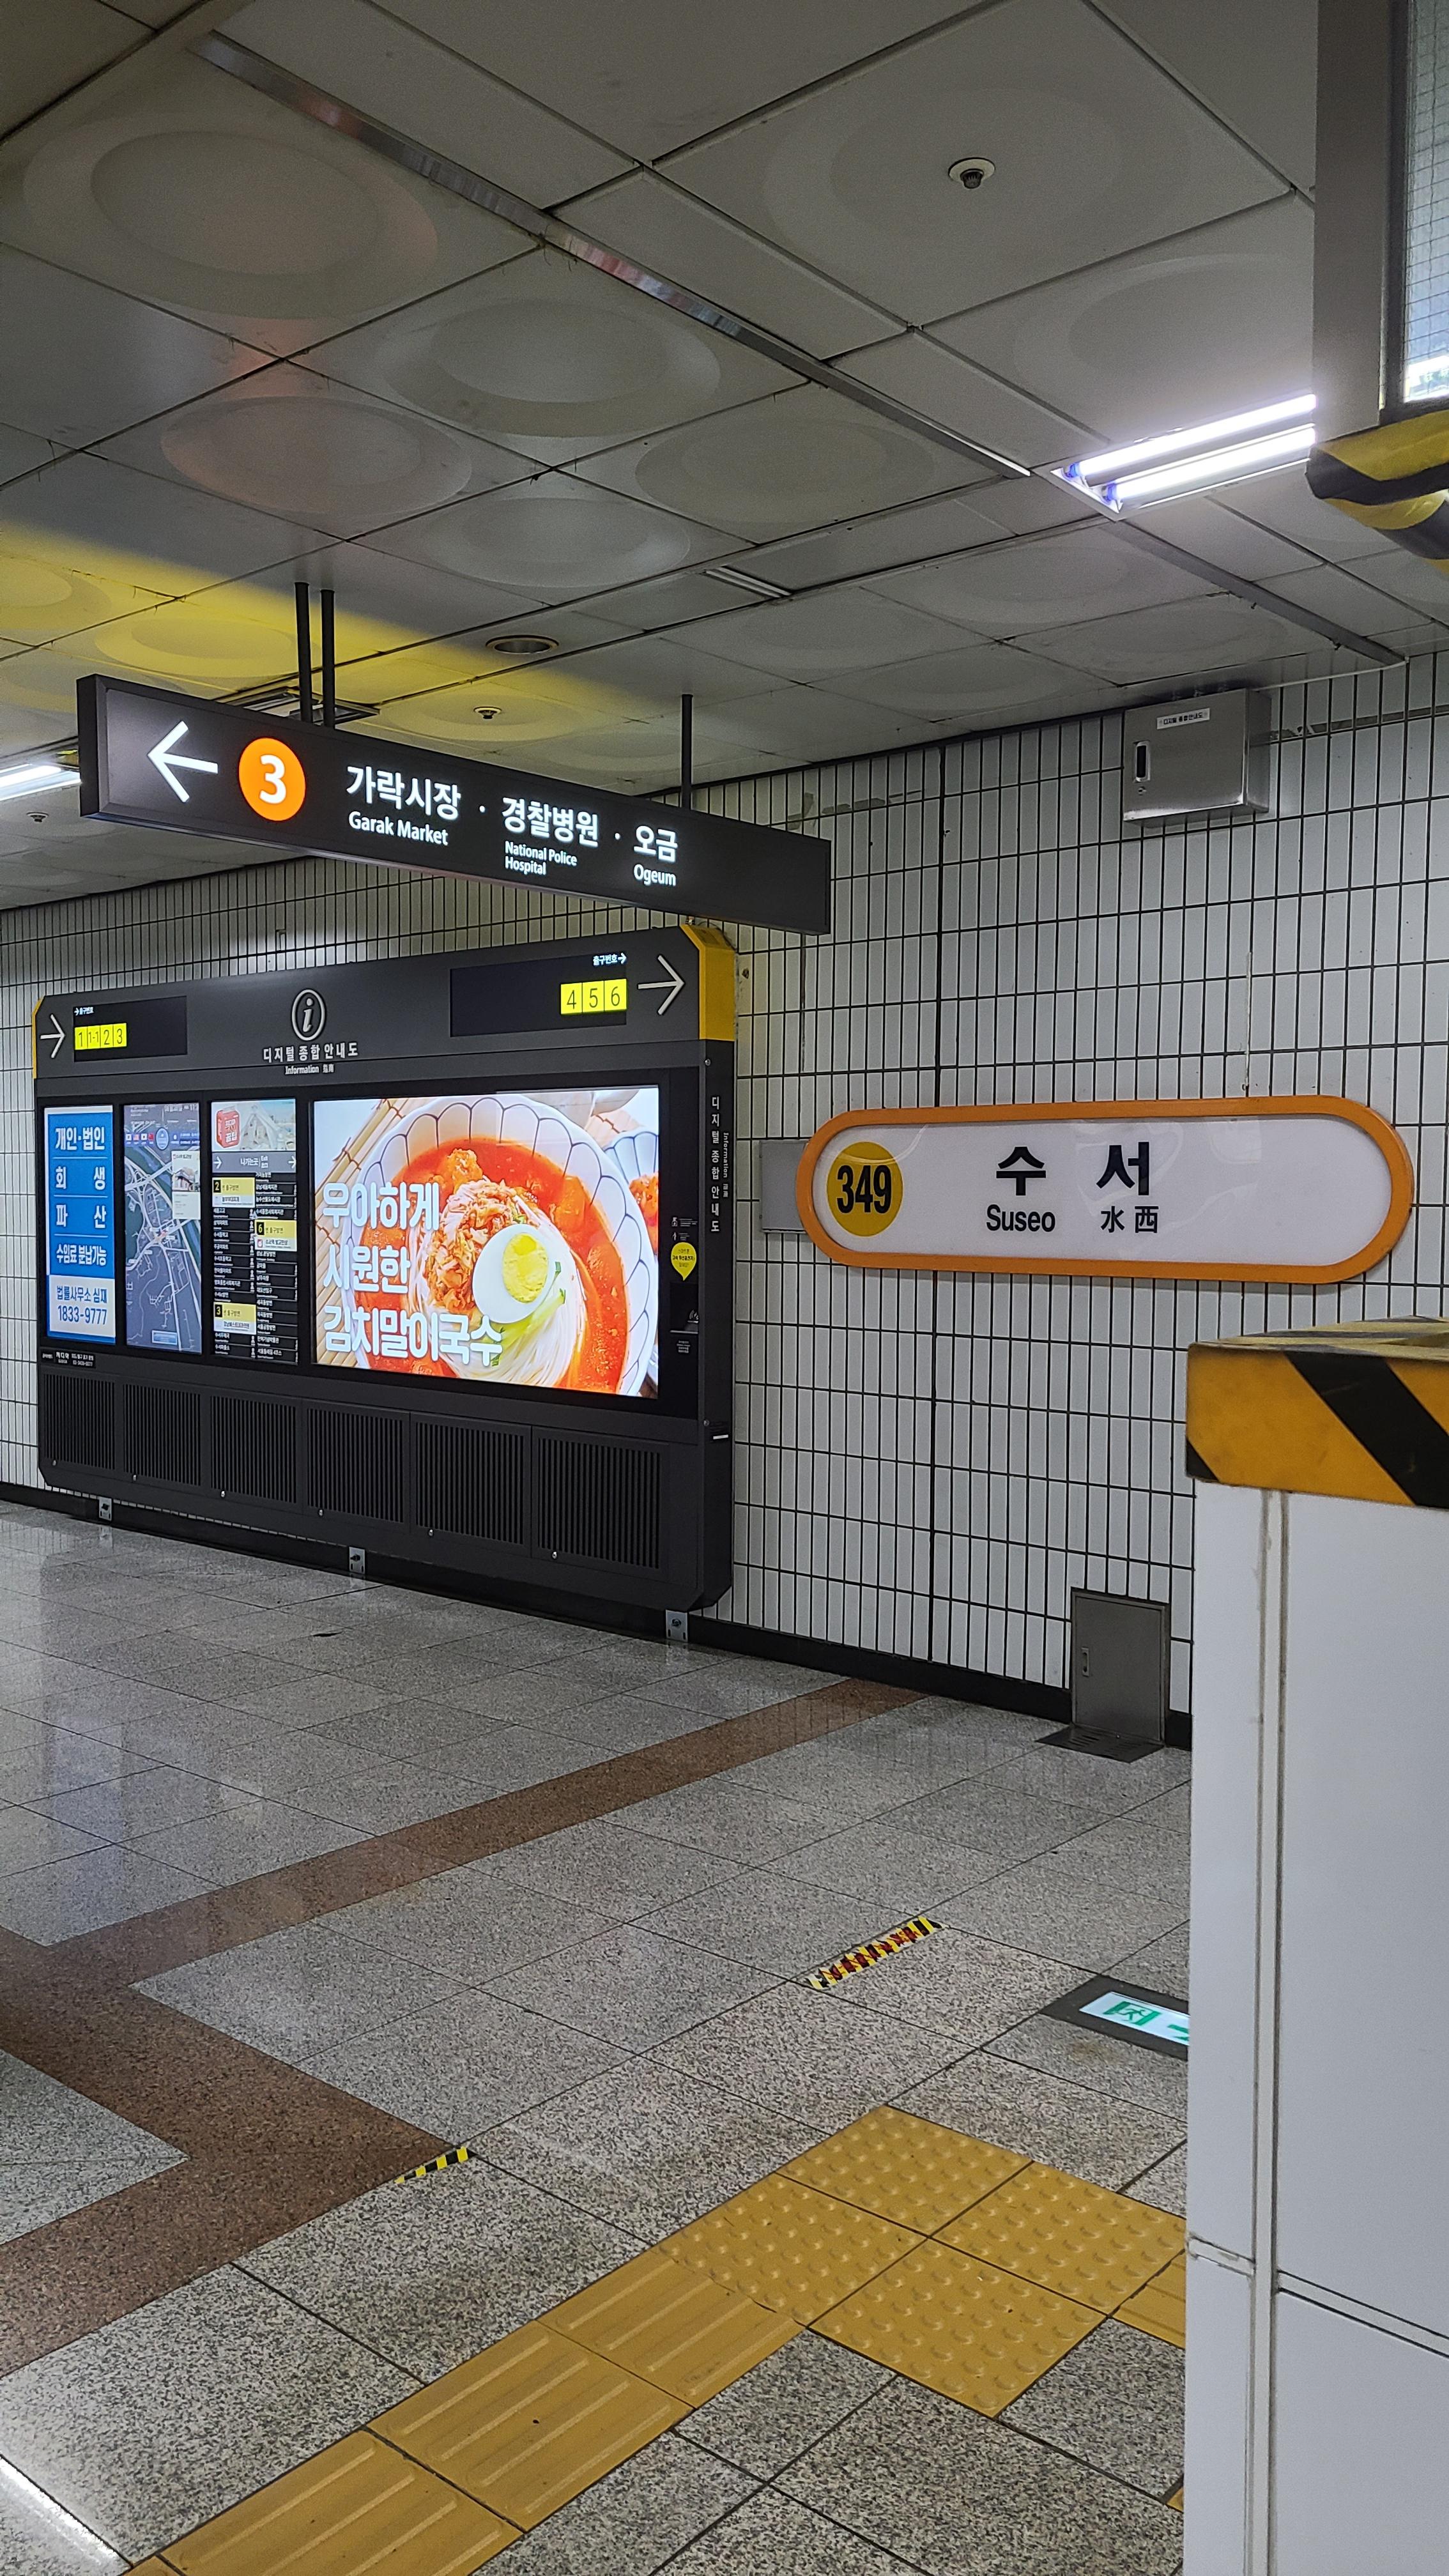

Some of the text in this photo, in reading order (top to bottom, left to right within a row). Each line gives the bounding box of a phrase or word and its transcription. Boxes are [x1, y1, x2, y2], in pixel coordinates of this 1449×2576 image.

[259, 755, 287, 804] 3
[346, 766, 678, 862] 가락시장 경찰병원 오금
[348, 811, 448, 846] Garak Market
[505, 840, 578, 866] National Police
[505, 856, 546, 875] Hospital
[633, 864, 677, 887] Ogeum
[567, 986, 620, 1009] 4 5 6
[79, 1028, 123, 1047] 1 1-1 2 3
[263, 1042, 358, 1063] 디지털 종합 안내도
[285, 1064, 319, 1075] Information
[711, 1096, 720, 1232] 디지털 종합 안내도
[836, 1163, 894, 1215] 349
[322, 1182, 440, 1231] 우아하게
[986, 1204, 1055, 1232] Suseo
[56, 1243, 107, 1266] 수임료 분납가능
[323, 1244, 411, 1294] 시원한
[57, 1285, 91, 1301] 법률사무소
[57, 1305, 107, 1325] 1833-9777
[323, 1305, 502, 1367] 김치말이국수
